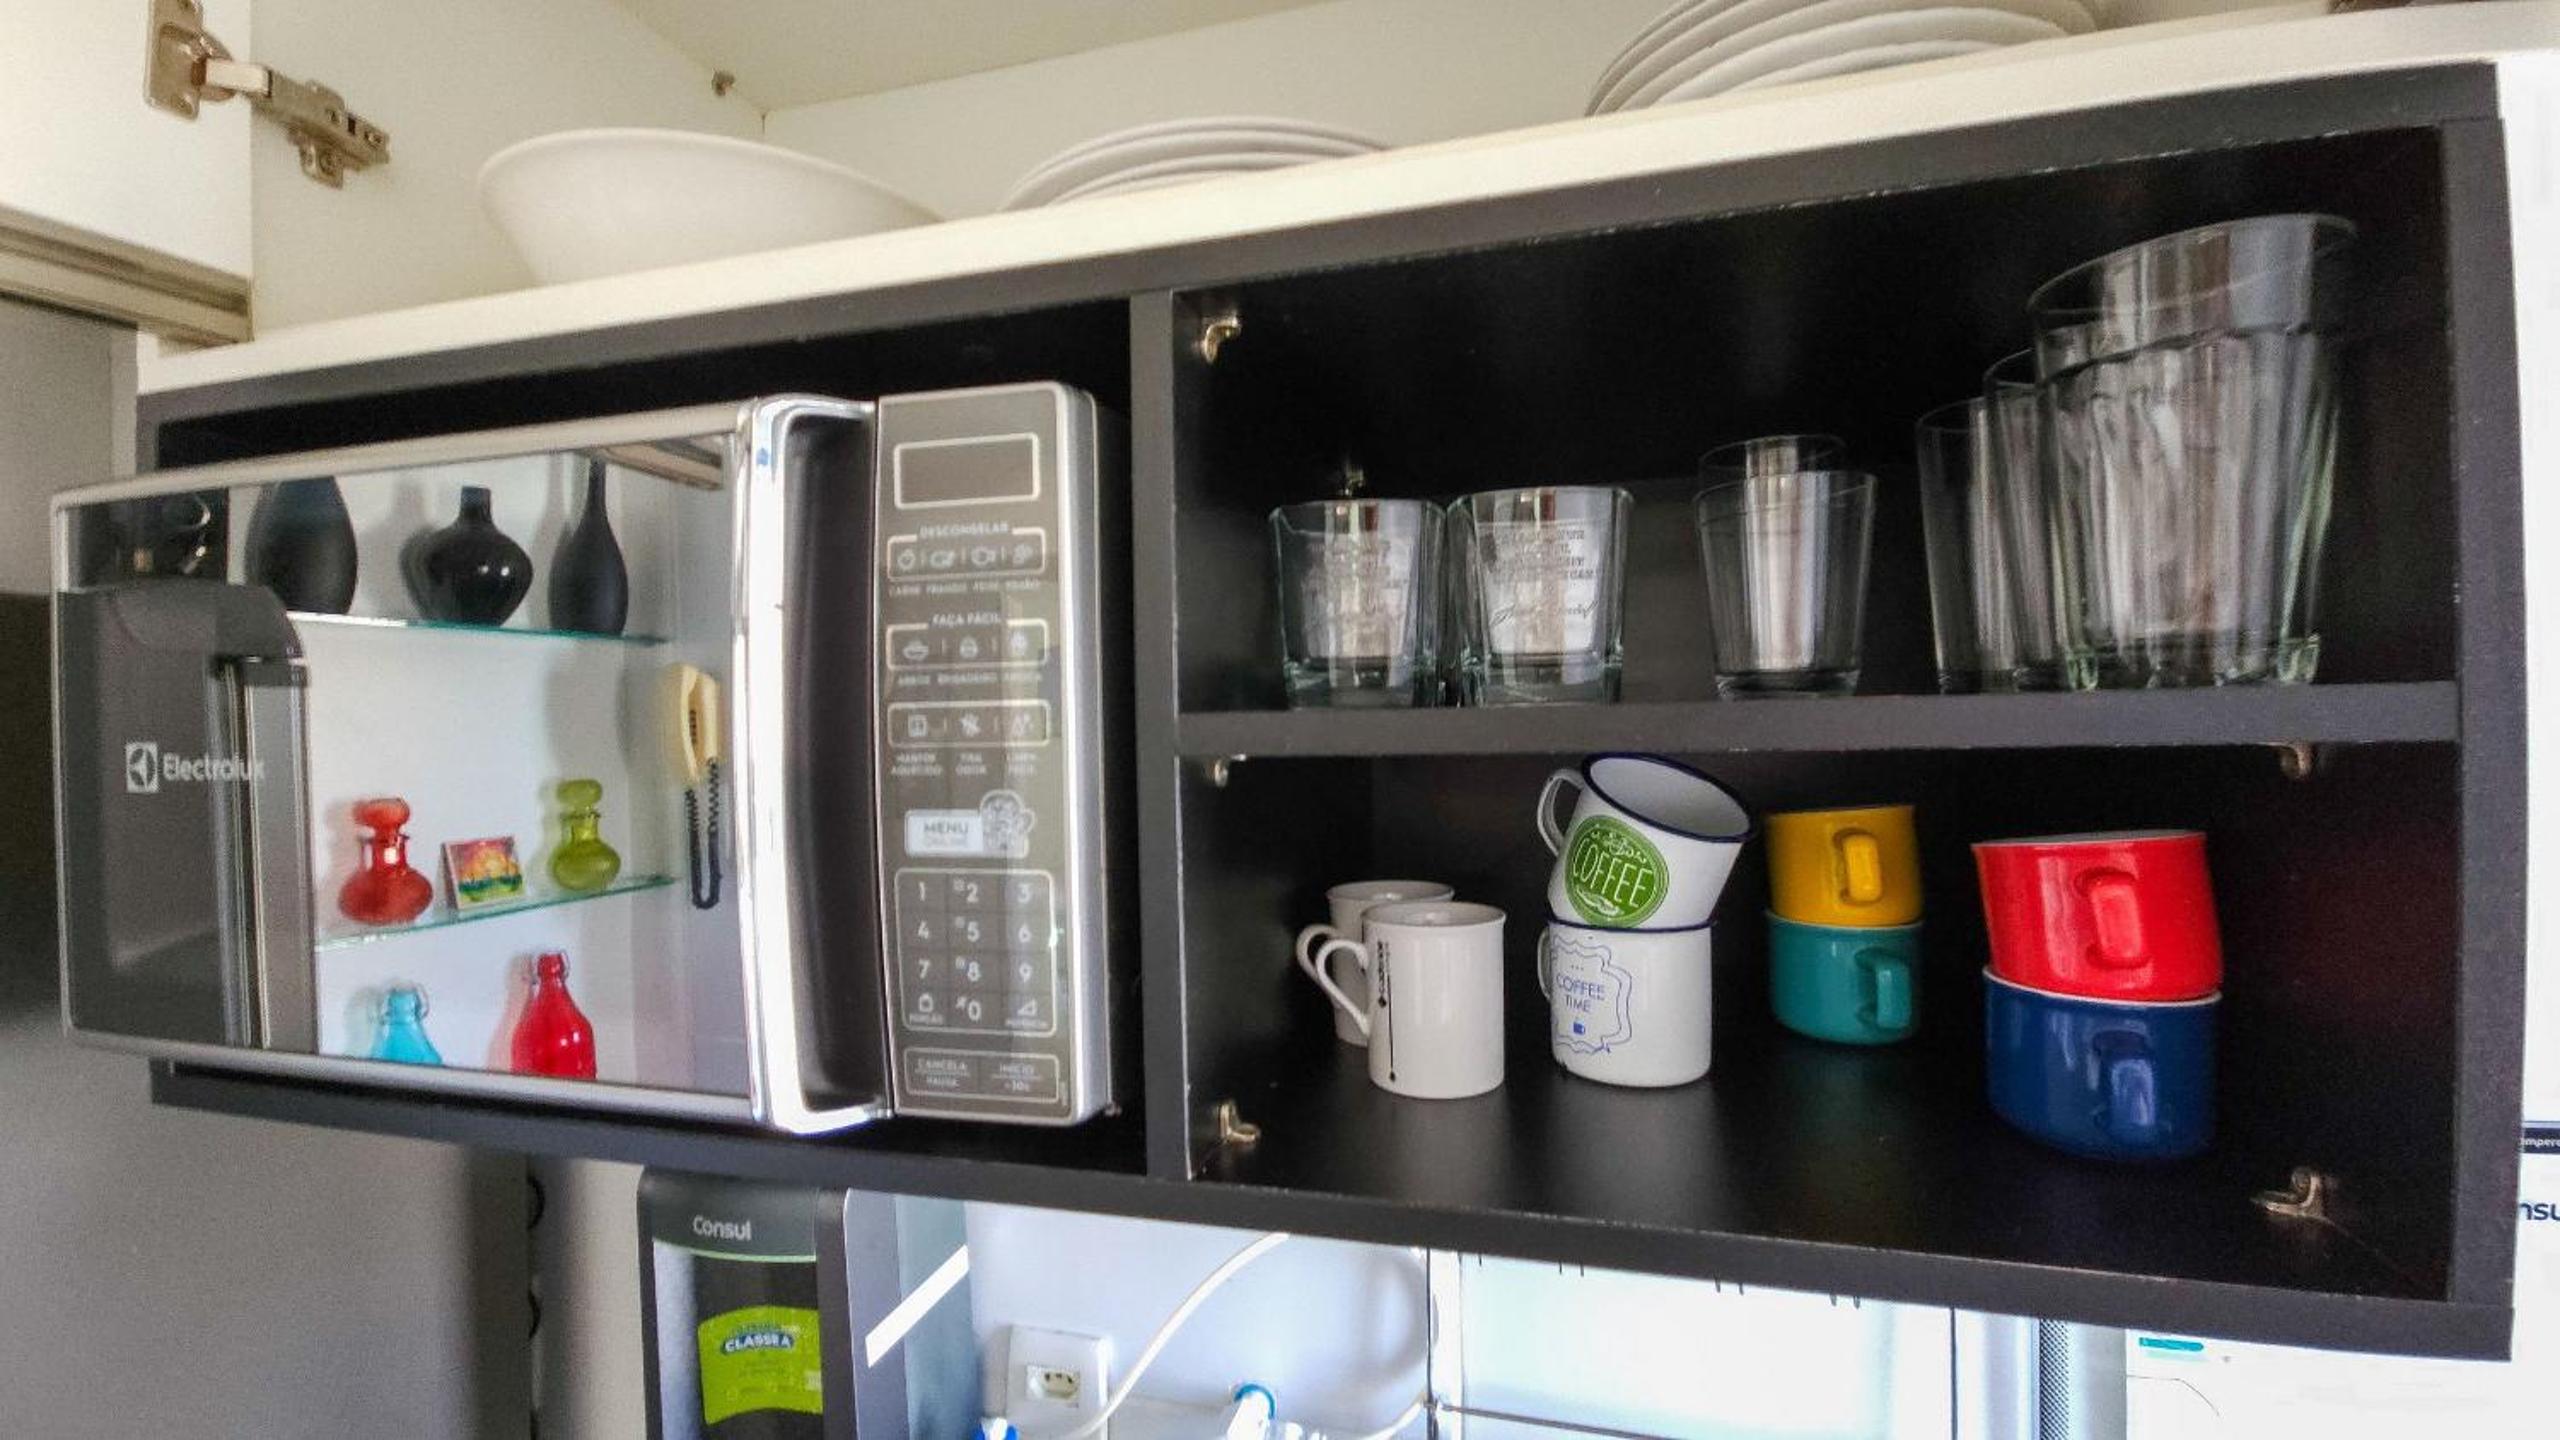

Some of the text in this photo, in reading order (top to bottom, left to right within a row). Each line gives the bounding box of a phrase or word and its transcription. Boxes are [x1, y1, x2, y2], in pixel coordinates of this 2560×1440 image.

[932, 614, 964, 627] FAÇA
[163, 752, 264, 780] Electrolux
[923, 821, 969, 834] MENU
[1573, 838, 1653, 908] COFFEE
[918, 881, 926, 902] 1
[966, 883, 979, 904] 2
[1017, 884, 1032, 904] 3
[917, 921, 929, 939] 4
[967, 921, 980, 942] 5
[1018, 923, 1031, 942] 6
[918, 959, 930, 979] 7
[967, 961, 980, 982] 8
[1019, 963, 1033, 982] 9
[1556, 974, 1605, 1001] COFFEE
[967, 999, 982, 1021] 0
[1566, 994, 1592, 1012] TIME
[692, 1214, 752, 1241] Consul
[780, 1336, 791, 1349] A
